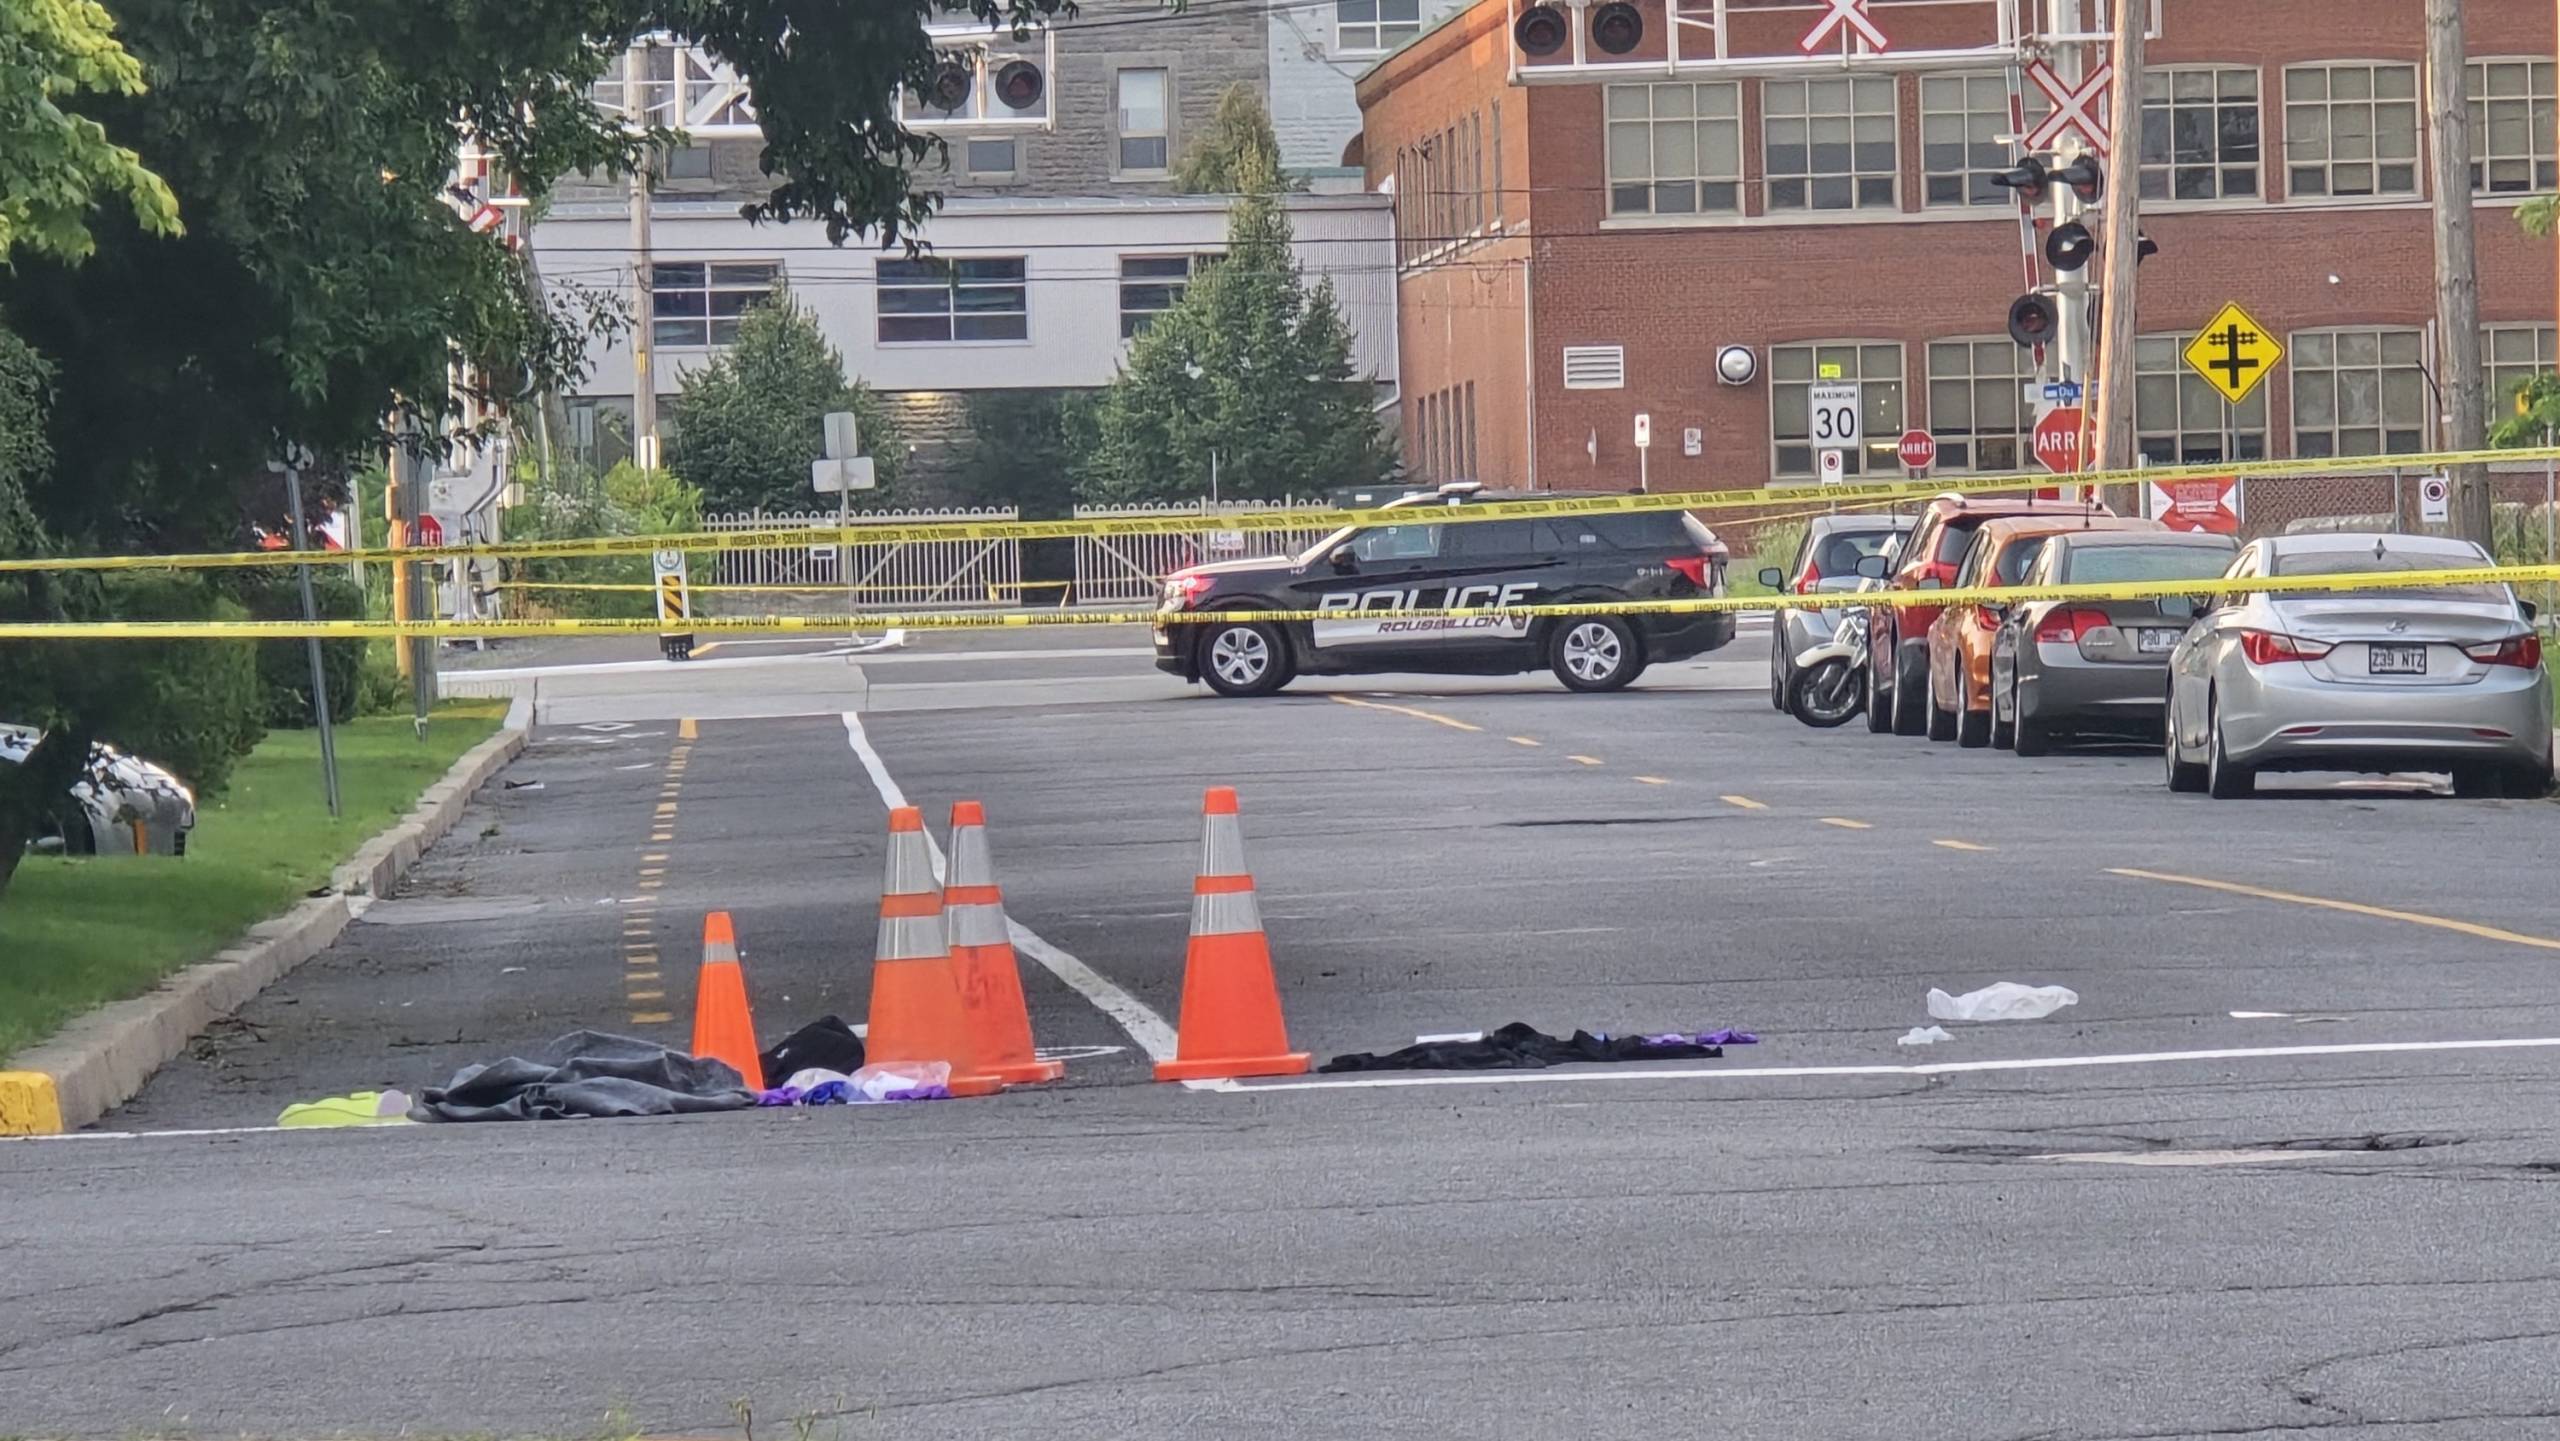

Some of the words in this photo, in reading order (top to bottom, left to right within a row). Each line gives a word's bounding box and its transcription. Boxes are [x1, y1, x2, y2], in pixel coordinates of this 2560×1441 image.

[1813, 391, 1856, 400] MAXIMUM
[1816, 407, 1855, 439] 30
[1318, 582, 1539, 612] POLICE
[1376, 615, 1504, 634] ROUSSILLON
[2372, 652, 2395, 667] 239
[2402, 652, 2425, 668] NTZ
